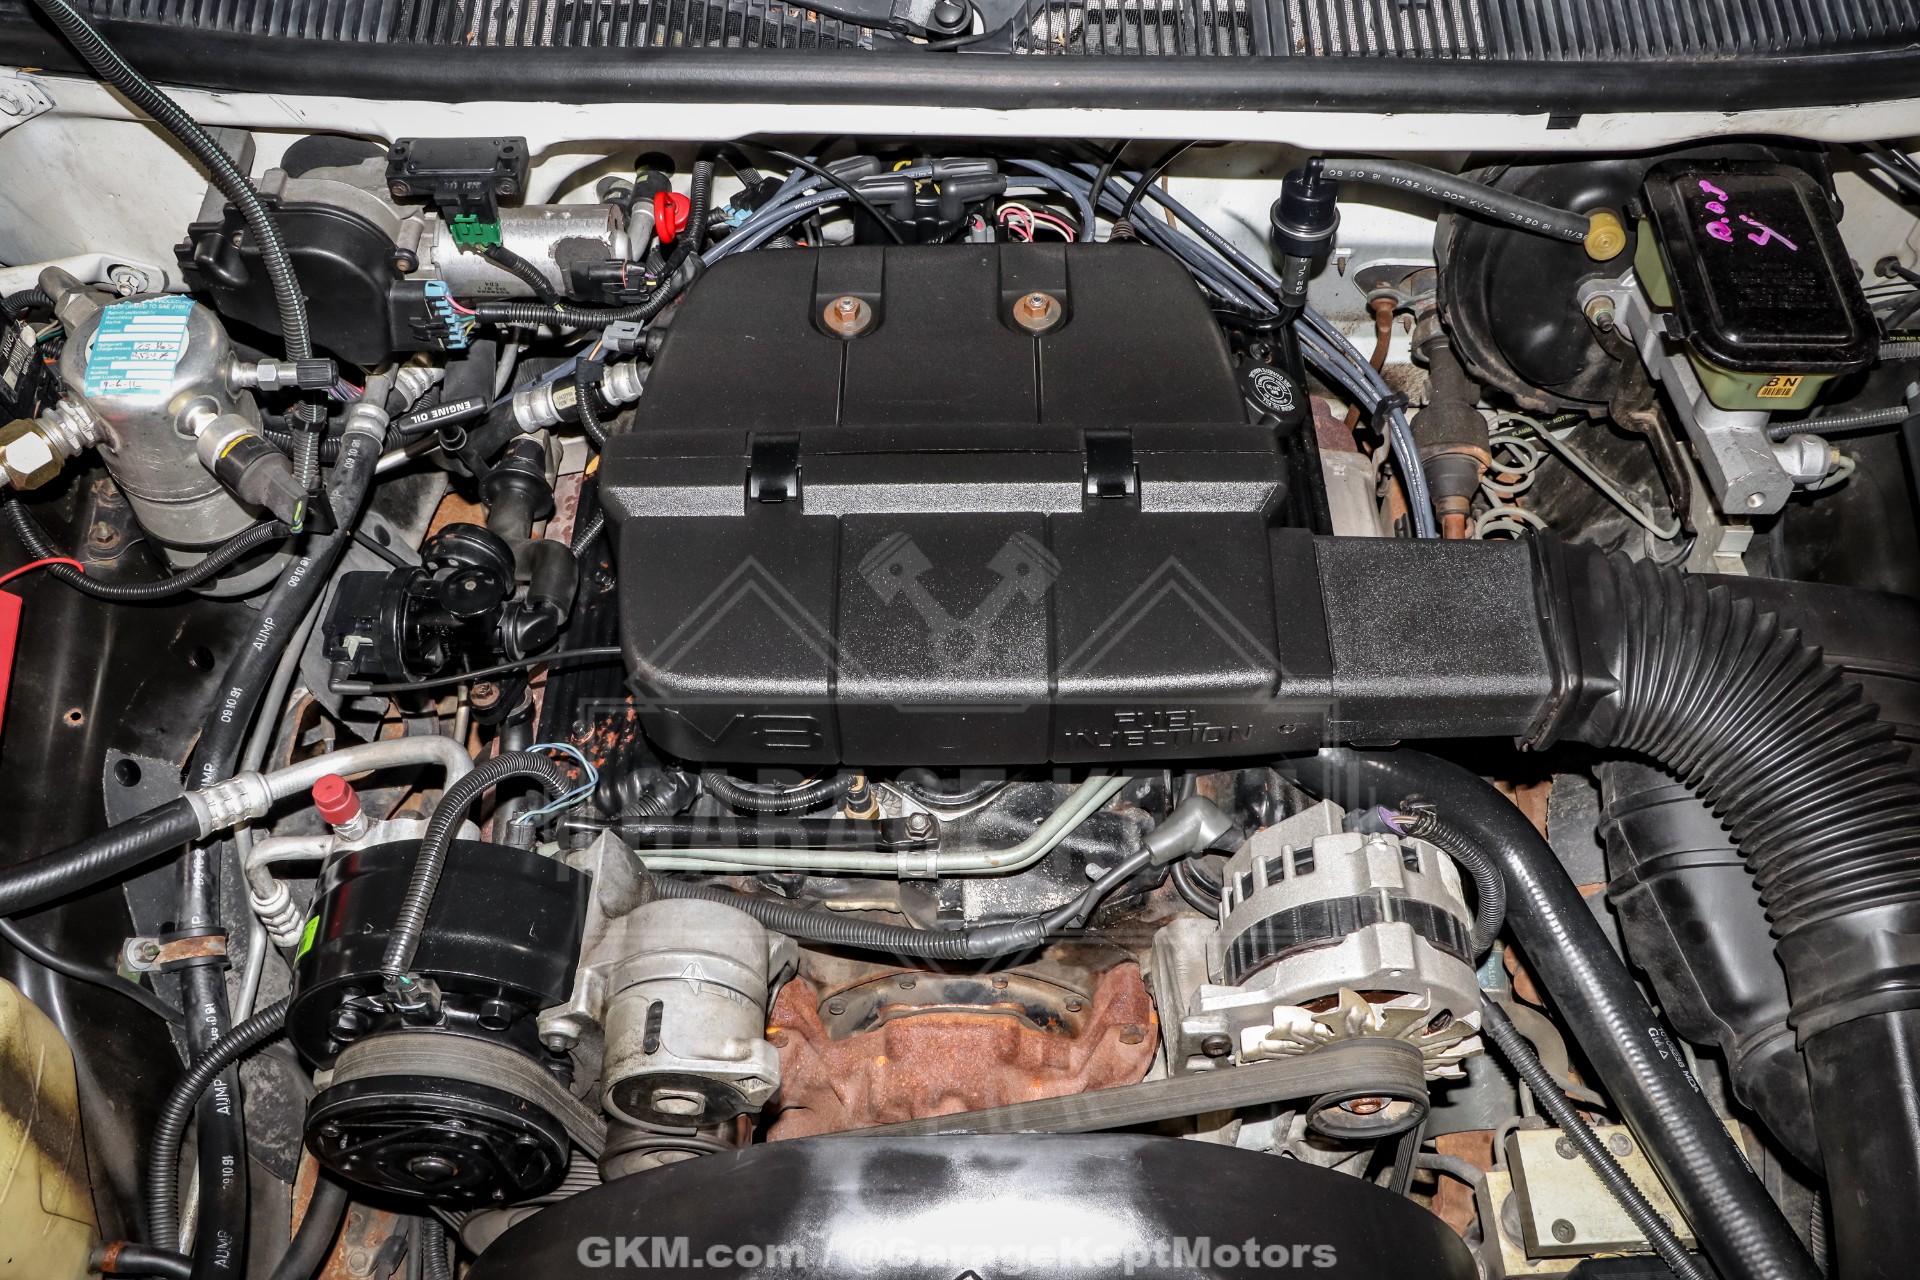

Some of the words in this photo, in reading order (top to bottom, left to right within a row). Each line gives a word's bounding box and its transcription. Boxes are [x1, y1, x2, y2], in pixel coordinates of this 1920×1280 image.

[1391, 176, 1420, 189] 11/32
[1442, 191, 1466, 202] DOT
[410, 412, 428, 424] OIL
[430, 401, 471, 418] ENGINE
[1113, 709, 1210, 729] FUEL
[664, 707, 824, 752] V8
[1064, 723, 1254, 750] INJECTION
[1648, 1027, 1664, 1047] GM
